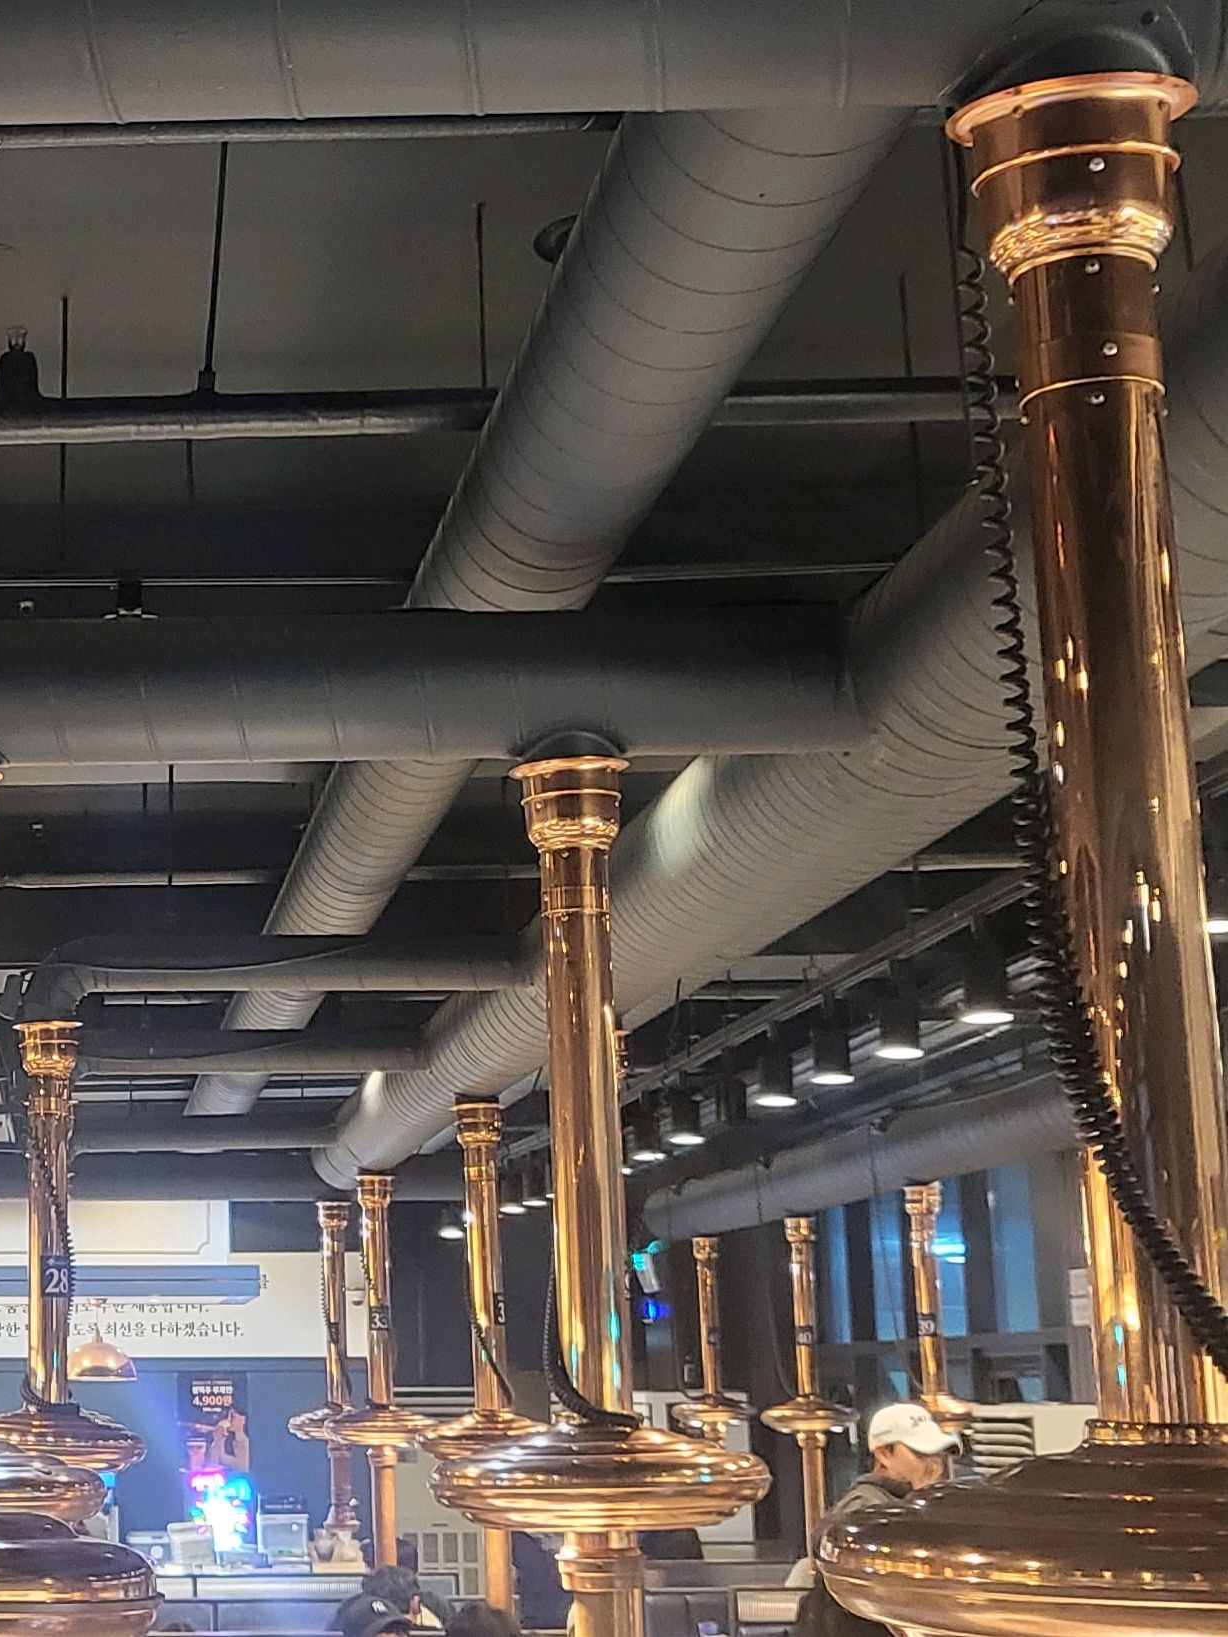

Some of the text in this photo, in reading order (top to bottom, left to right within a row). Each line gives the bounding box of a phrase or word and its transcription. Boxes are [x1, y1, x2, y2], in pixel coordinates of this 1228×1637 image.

[45, 1268, 69, 1293] 28
[104, 1321, 147, 1338] 최선을
[151, 1320, 244, 1338] 다하겠습니다.
